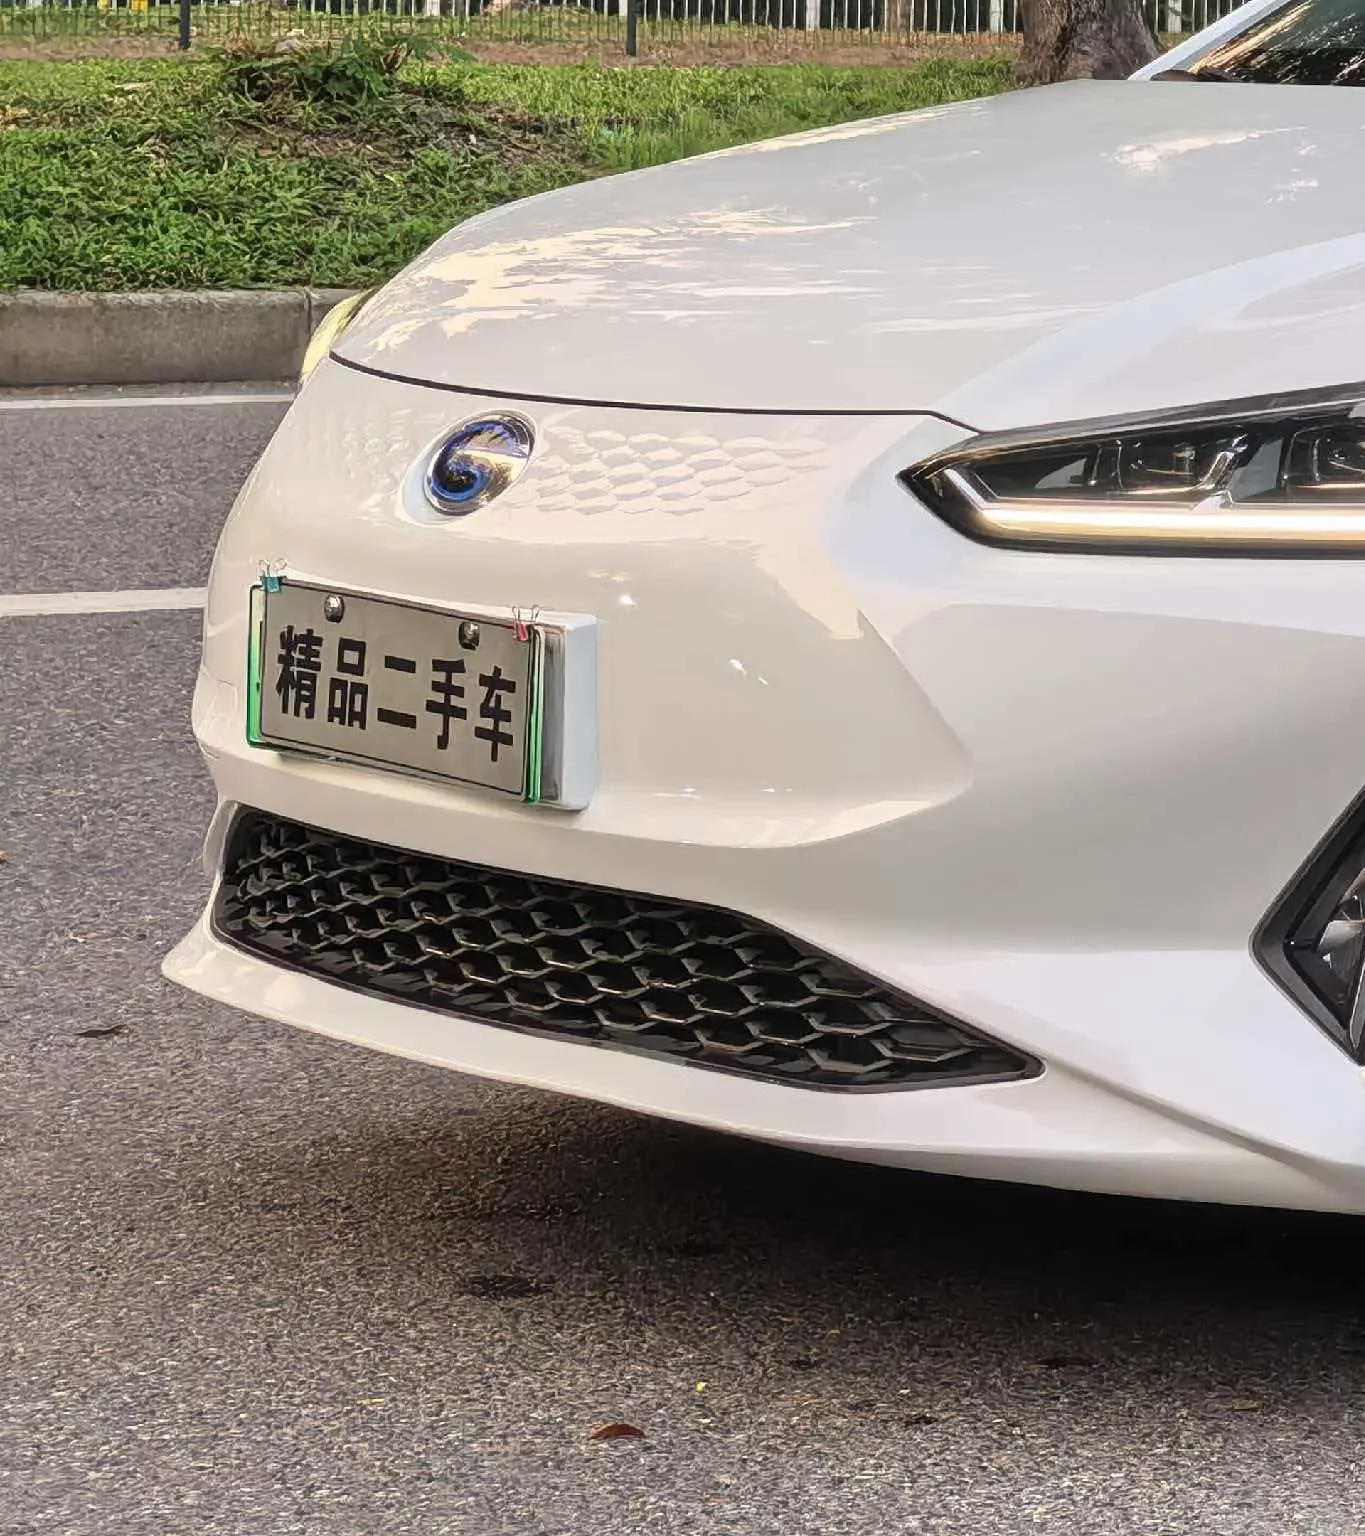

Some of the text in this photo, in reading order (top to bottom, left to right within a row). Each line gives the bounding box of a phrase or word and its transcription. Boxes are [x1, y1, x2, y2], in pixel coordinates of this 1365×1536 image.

[276, 625, 516, 762] 精品二手车
